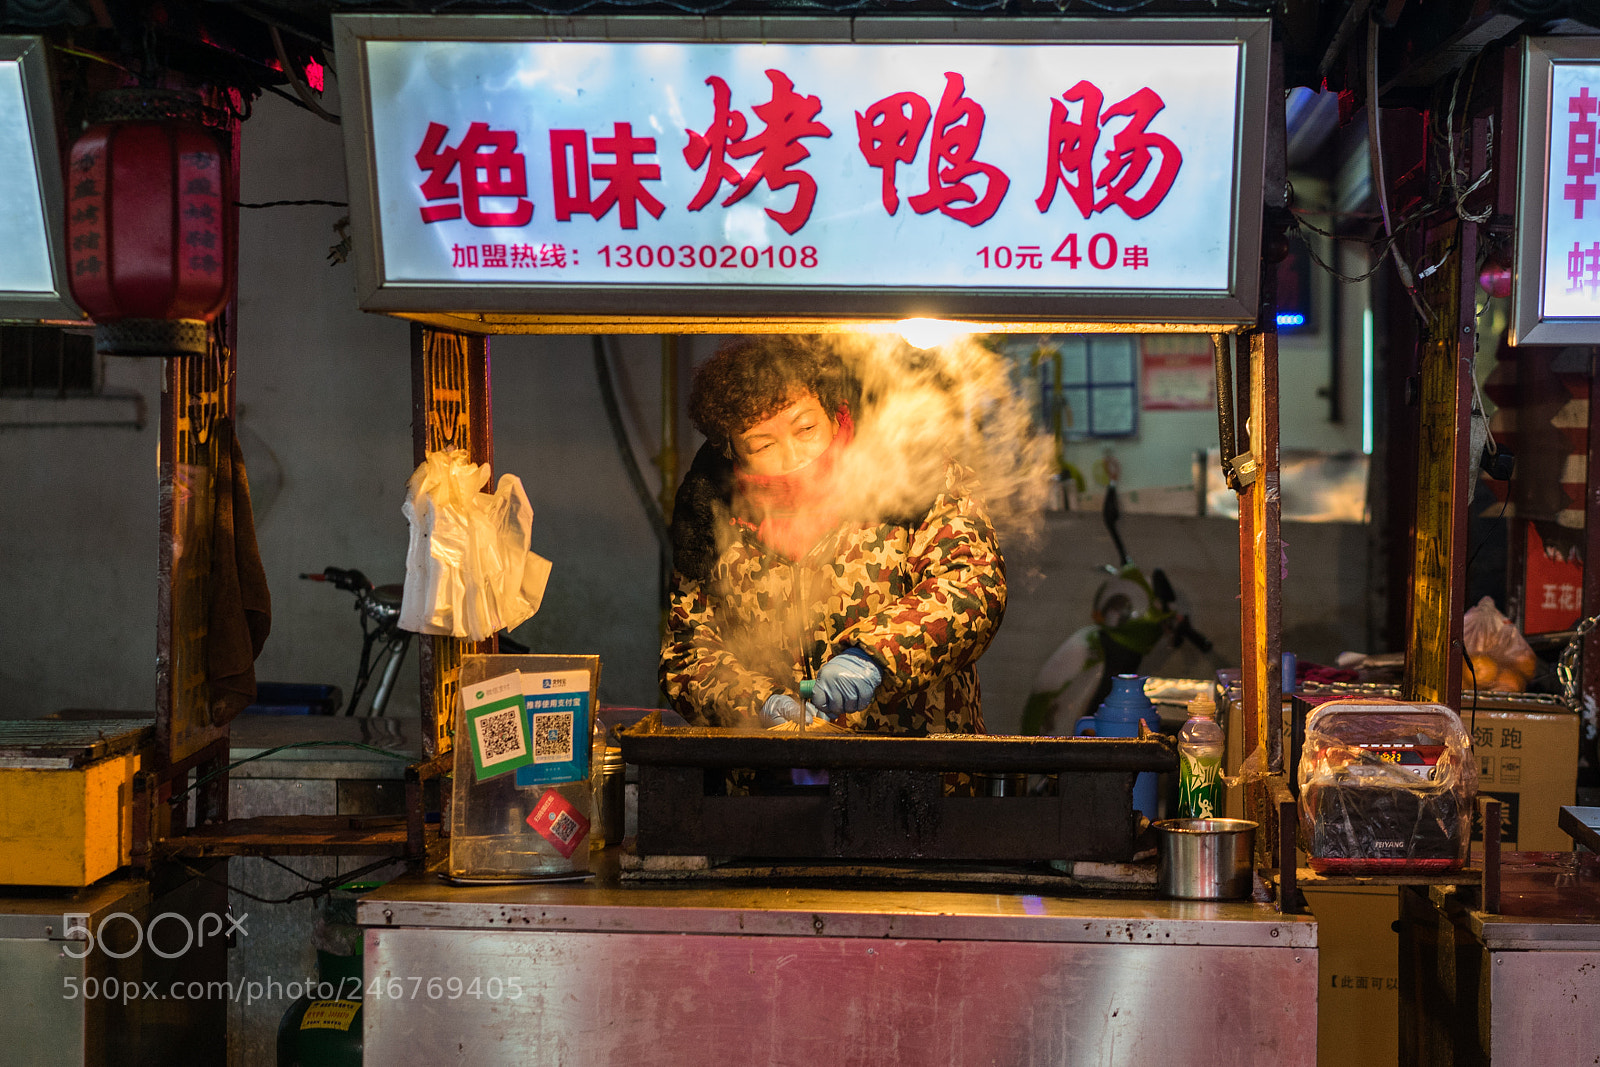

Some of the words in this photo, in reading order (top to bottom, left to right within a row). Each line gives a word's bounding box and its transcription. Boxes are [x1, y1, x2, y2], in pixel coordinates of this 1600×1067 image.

[526, 698, 581, 710] 推荐使用支付宝
[1375, 841, 1404, 849] FEIYANG
